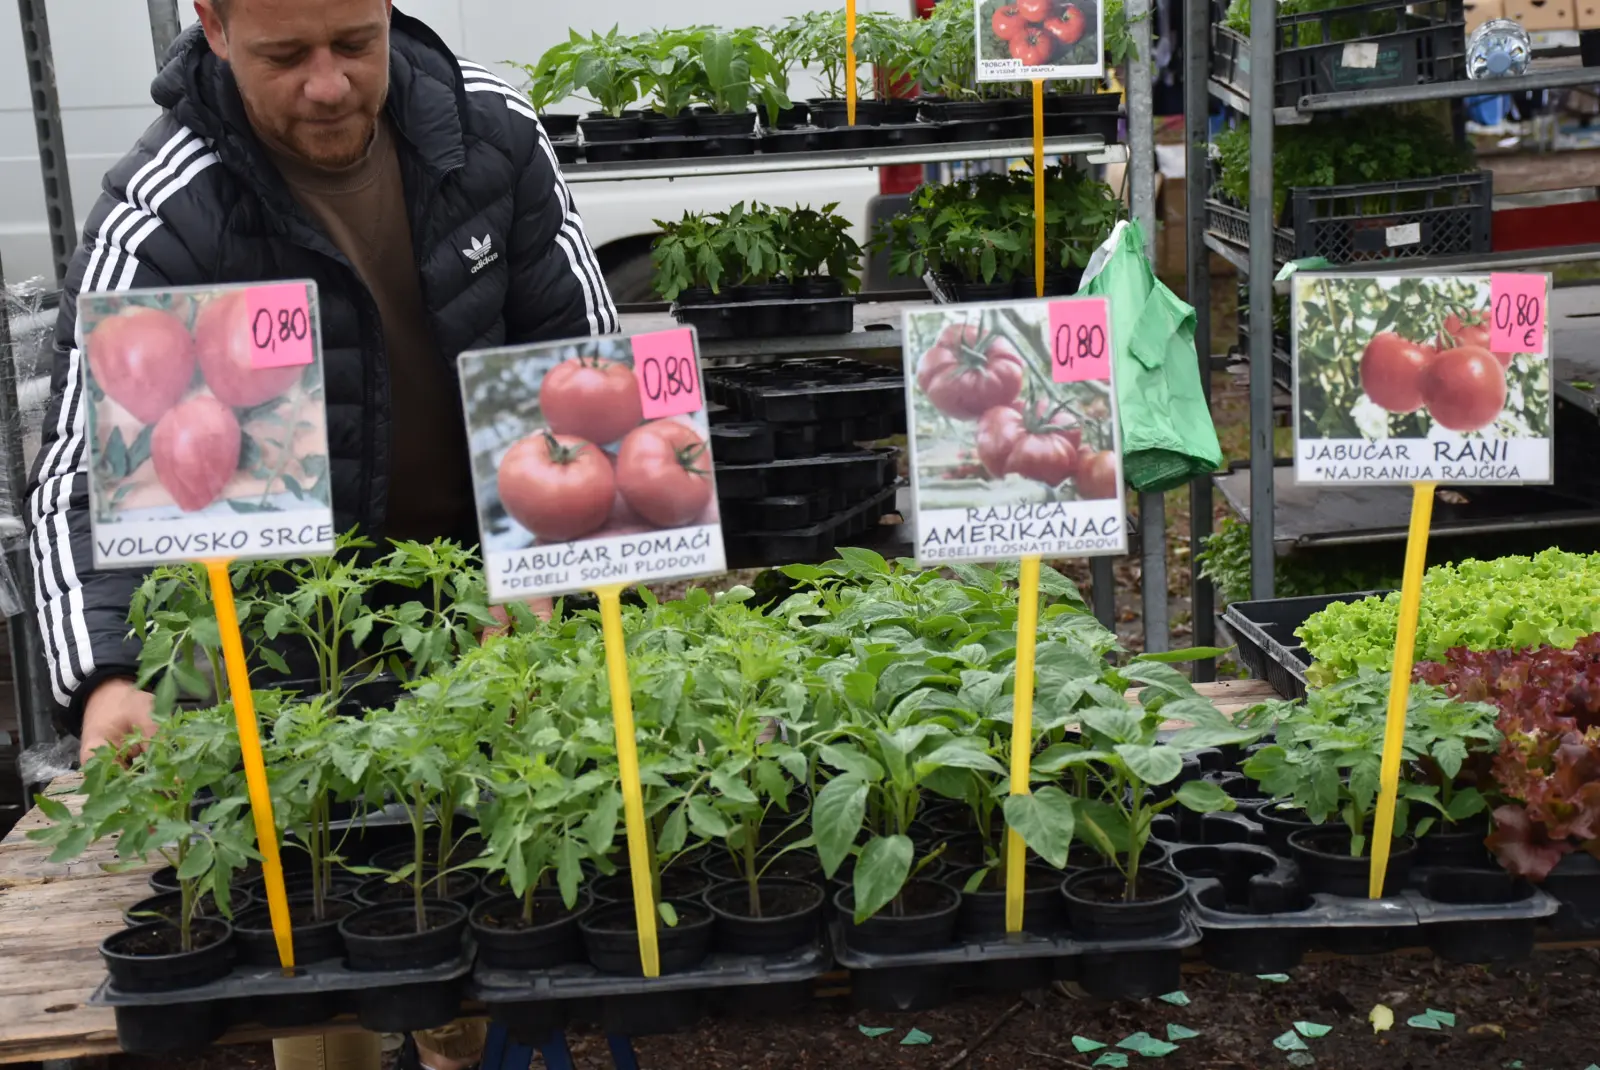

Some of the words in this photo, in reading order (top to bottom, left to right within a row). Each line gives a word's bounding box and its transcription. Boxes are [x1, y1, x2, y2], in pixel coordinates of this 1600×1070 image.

[471, 252, 499, 274] adidas
[252, 307, 308, 354] 0,80
[1495, 292, 1541, 338] 0,80
[1055, 323, 1106, 370] 0,80
[1523, 328, 1537, 348] €
[643, 355, 694, 403] 0,80
[1304, 439, 1412, 462] JABUČAR
[1433, 440, 1509, 463] RANI
[1440, 460, 1521, 480] RAJČICA
[965, 499, 1067, 523] RAJČICA
[97, 529, 249, 558] VOLOVSKO
[259, 523, 334, 548] SRCE
[922, 515, 1121, 548] AMERIKANAC
[983, 541, 1053, 556] PLOSNATI
[1054, 537, 1120, 552] PLODOVI
[501, 542, 612, 575] JABUČAR
[620, 531, 711, 557] DOMAĆI
[580, 561, 628, 582] SOČNI
[635, 553, 707, 574] PLODOVI
